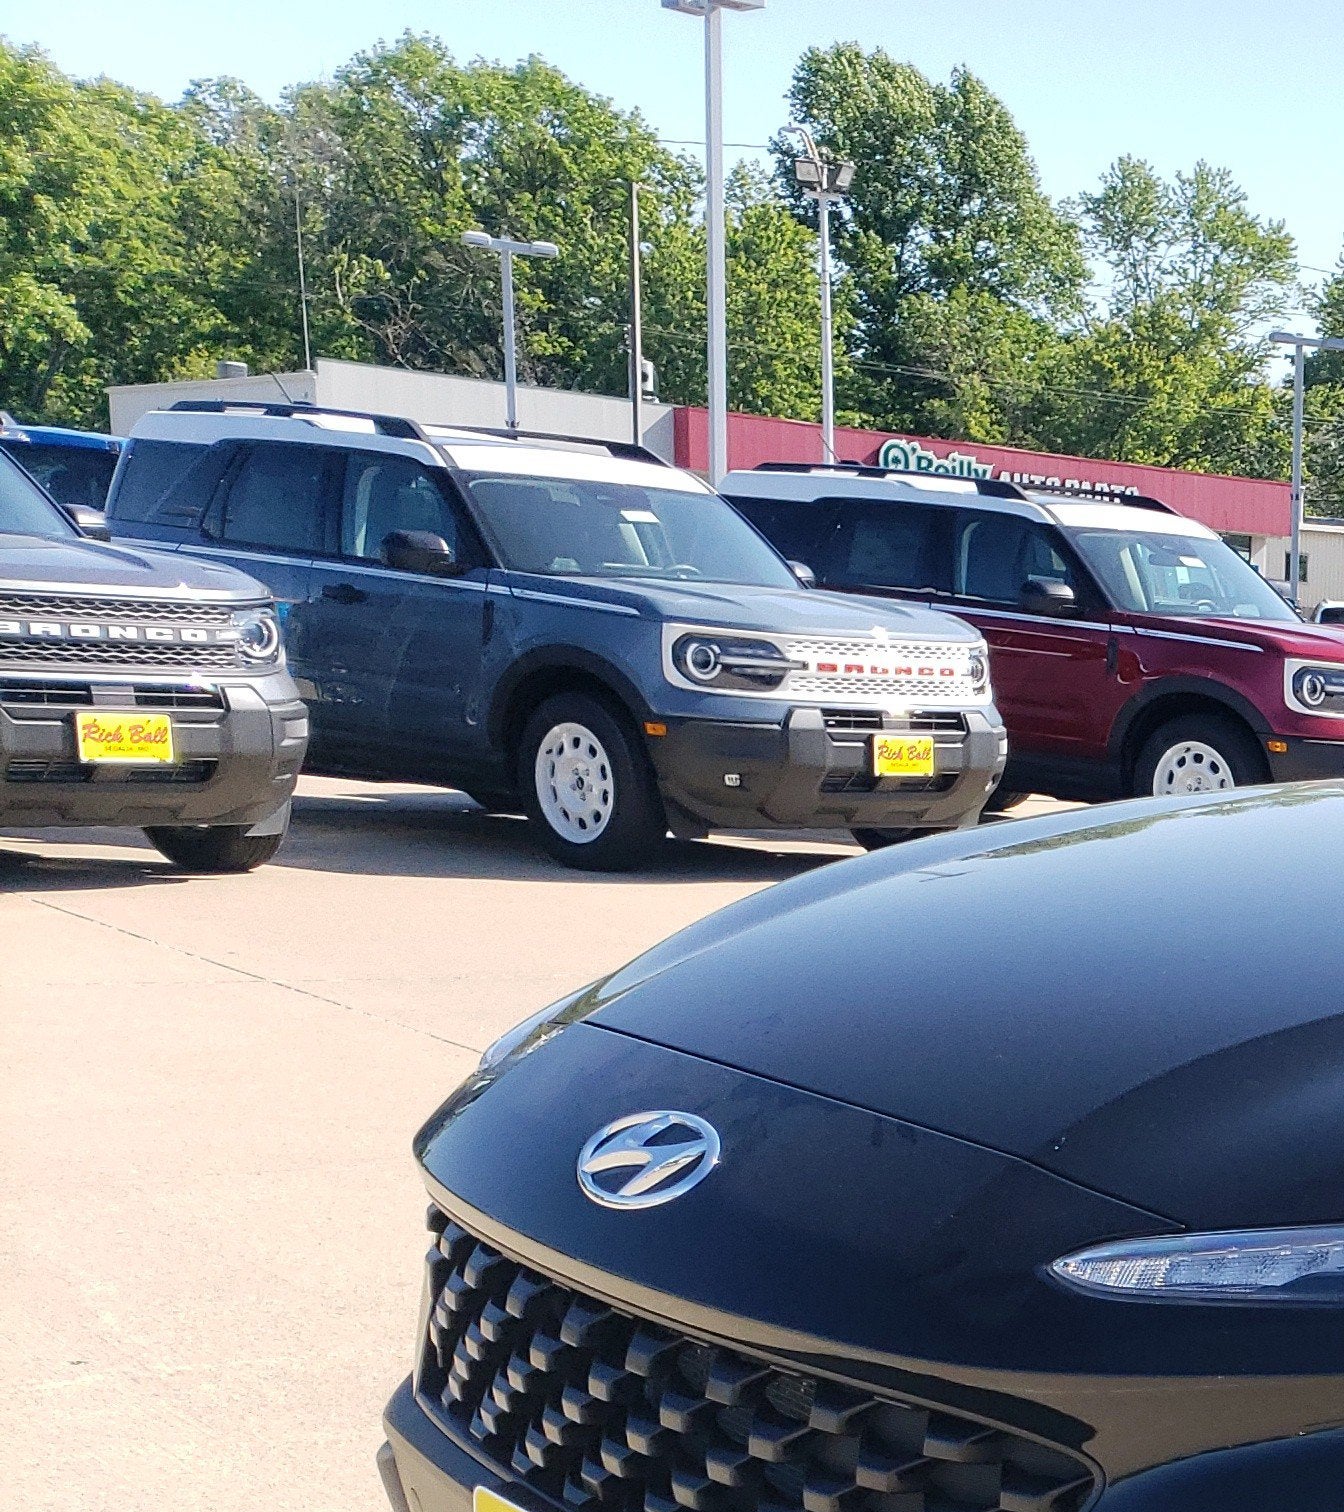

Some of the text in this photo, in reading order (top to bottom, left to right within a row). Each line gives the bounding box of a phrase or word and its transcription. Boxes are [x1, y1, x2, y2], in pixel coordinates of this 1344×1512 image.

[817, 663, 954, 676] BRONCO
[82, 723, 168, 744] Rich Ball
